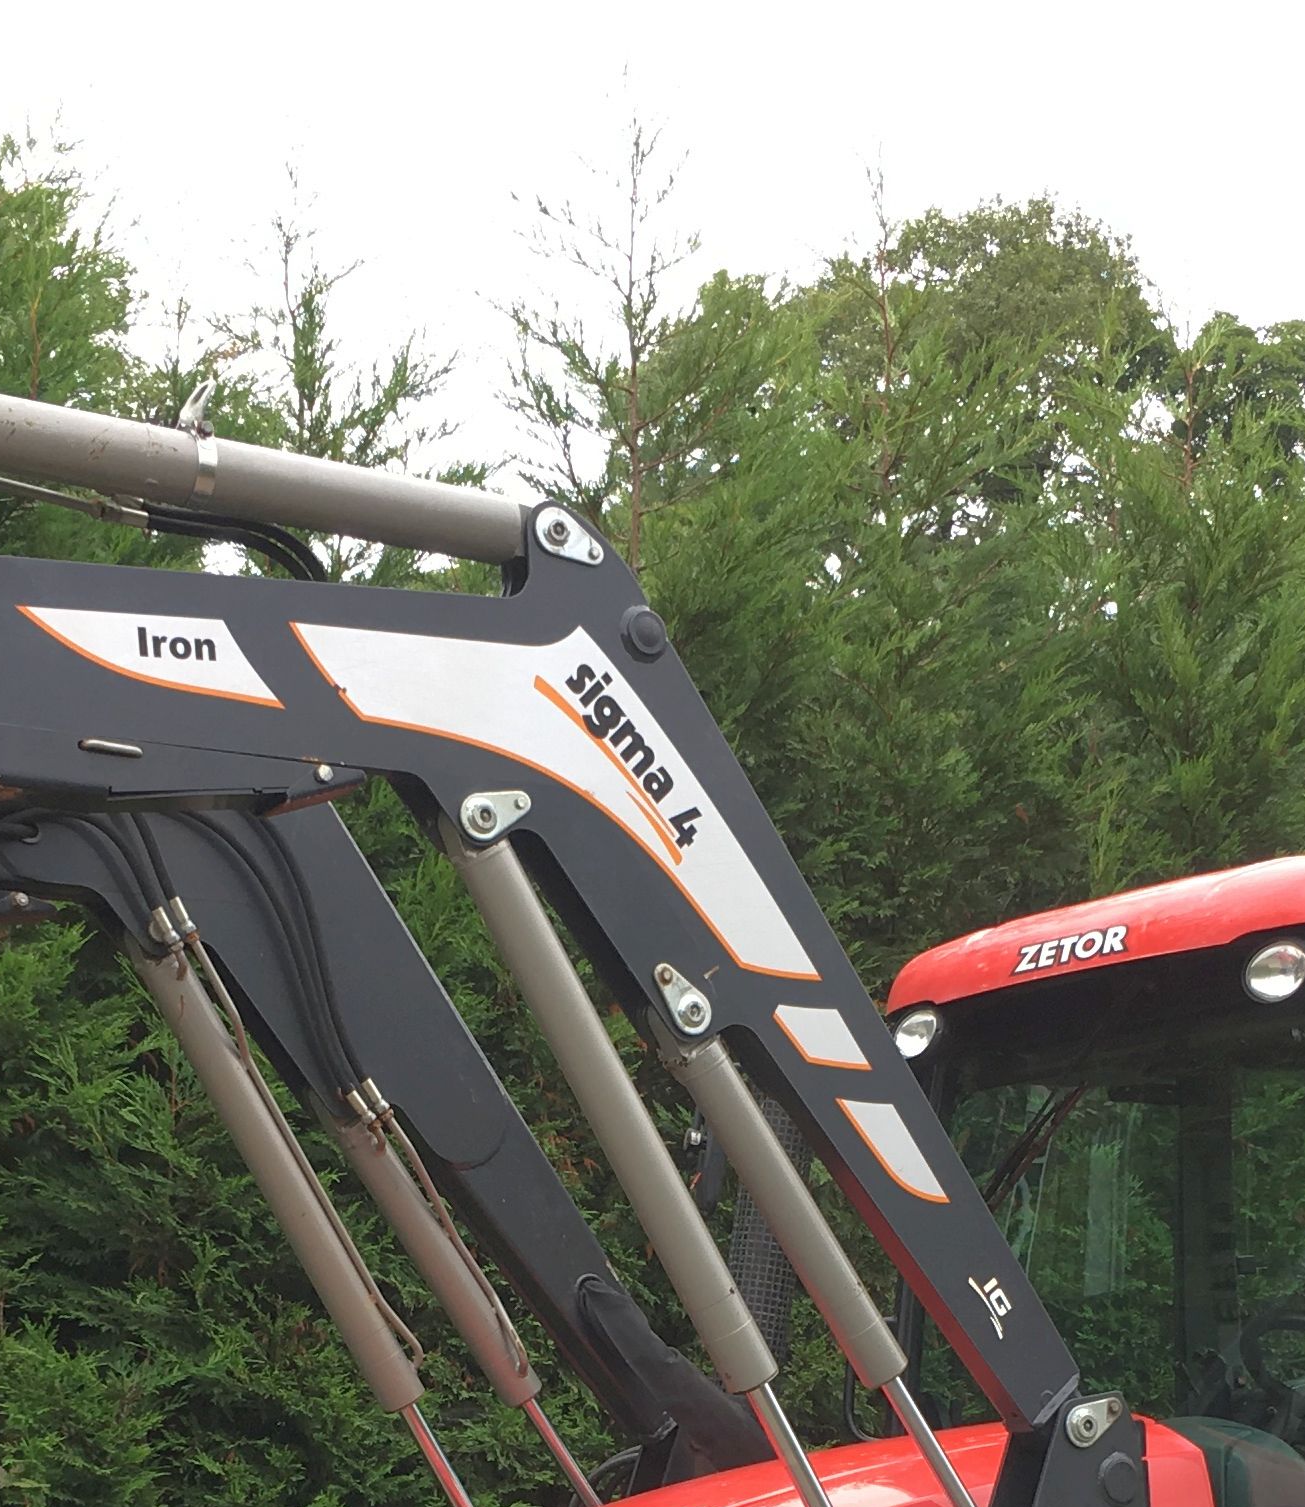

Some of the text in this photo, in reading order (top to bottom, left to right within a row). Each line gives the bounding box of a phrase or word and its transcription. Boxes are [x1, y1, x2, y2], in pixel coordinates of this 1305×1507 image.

[137, 626, 217, 661] Iron
[564, 663, 703, 849] sigma 4
[1012, 924, 1128, 974] ZETOR
